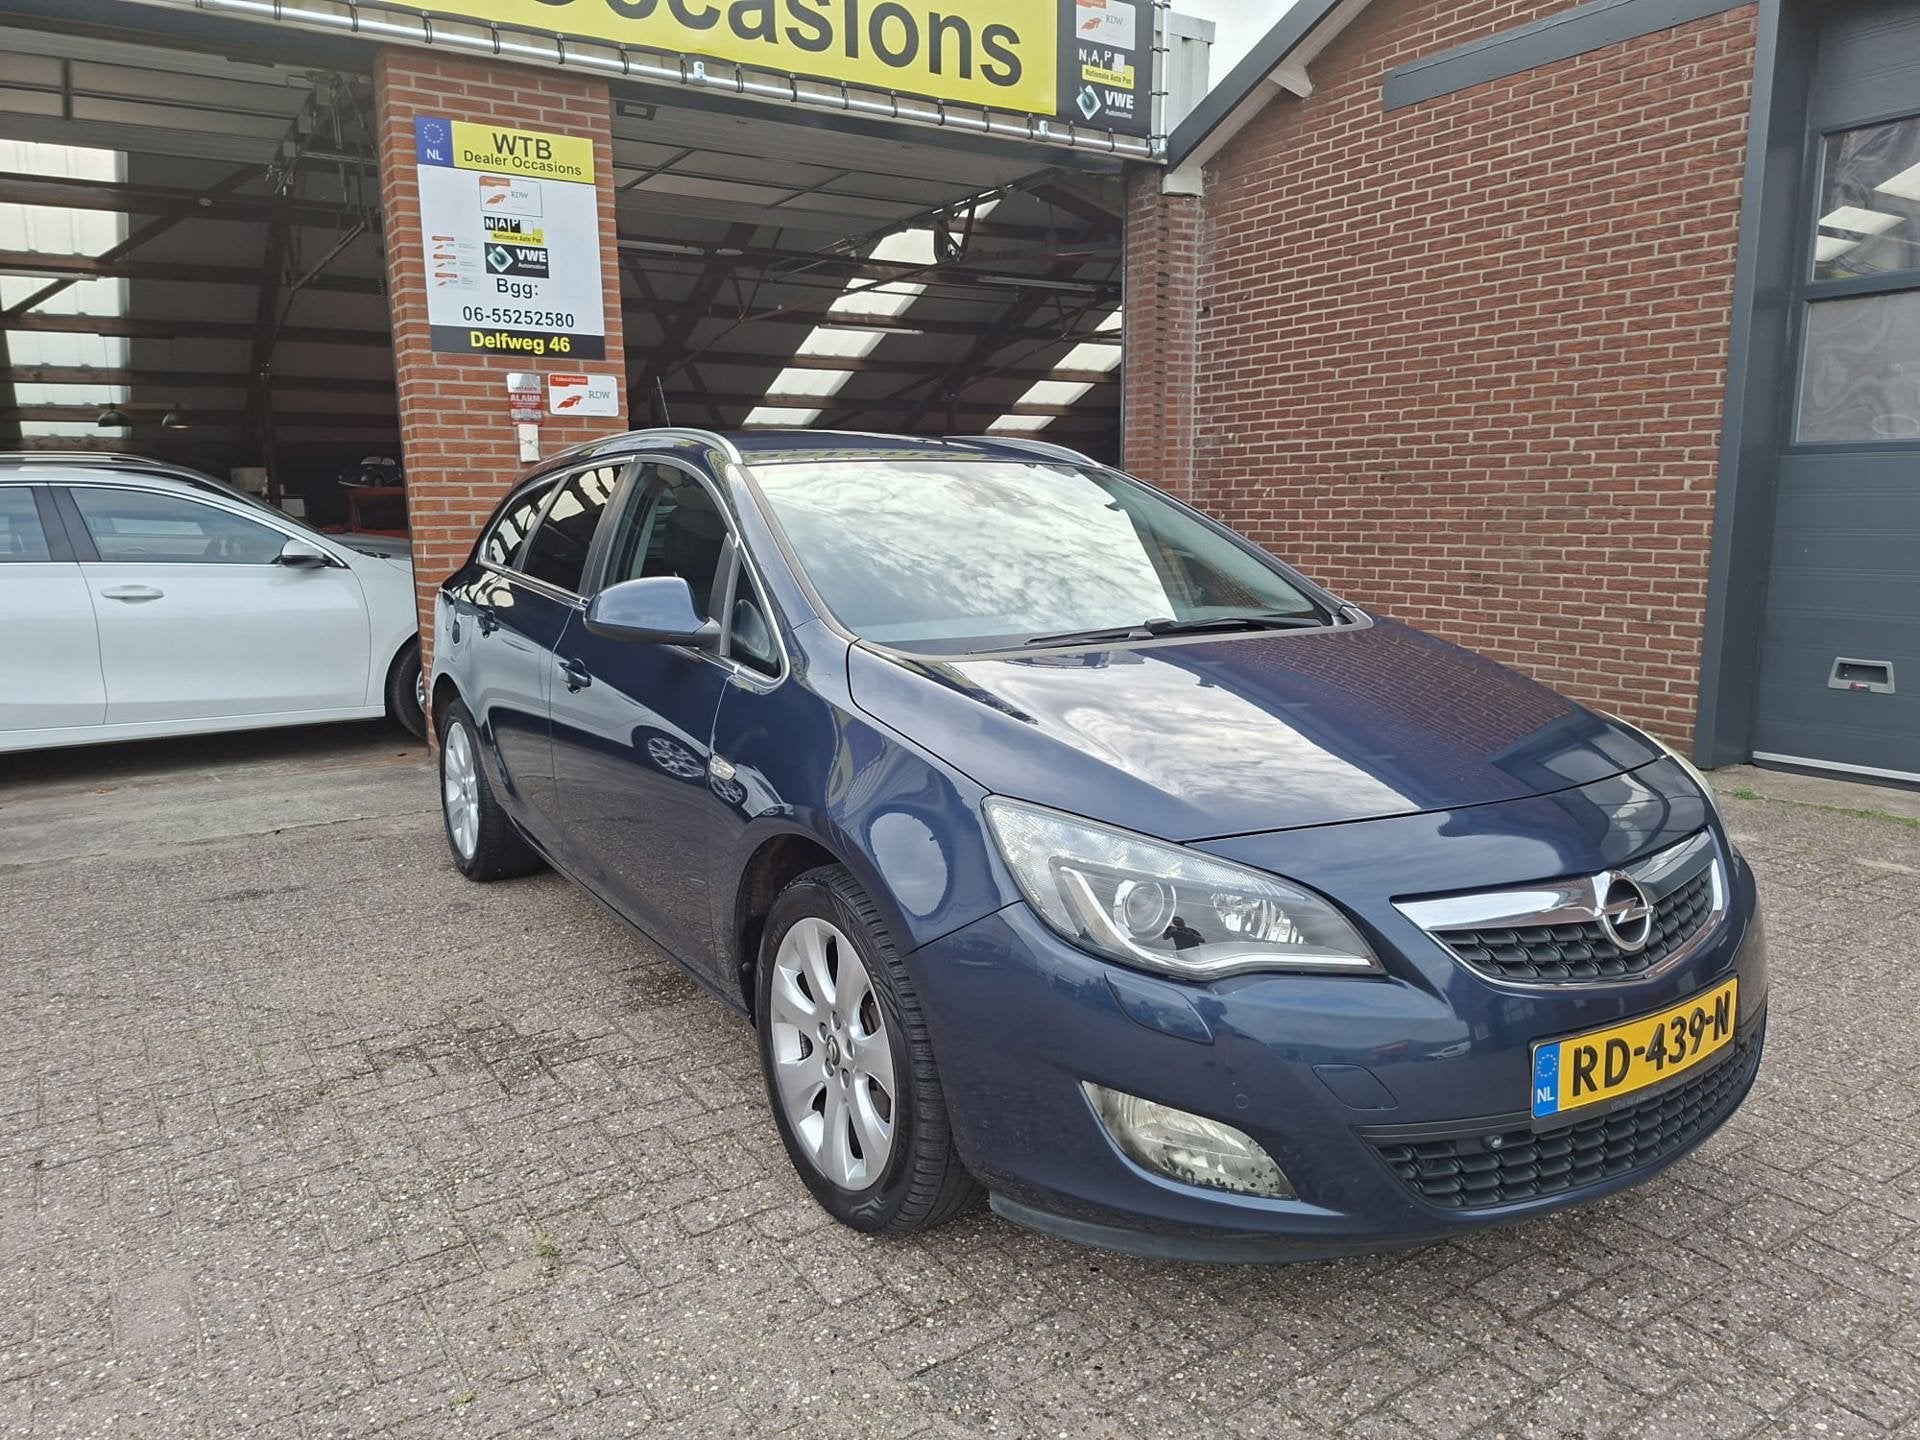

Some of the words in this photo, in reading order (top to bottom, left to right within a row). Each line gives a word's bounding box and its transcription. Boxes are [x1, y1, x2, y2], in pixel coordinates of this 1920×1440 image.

[1105, 90, 1134, 110] VWE
[426, 148, 443, 161] NL
[492, 132, 552, 160] WTB
[463, 150, 508, 167] Dealer
[512, 156, 582, 176] Occasions
[516, 248, 547, 262] VWE
[496, 278, 539, 298] Bgg:
[462, 306, 575, 328] 06-55252580
[470, 331, 545, 354] Delfweg
[549, 336, 571, 352] 46
[588, 390, 611, 399] RDW
[1572, 990, 1730, 1097] RD-439-N
[1536, 1087, 1555, 1104] NL
